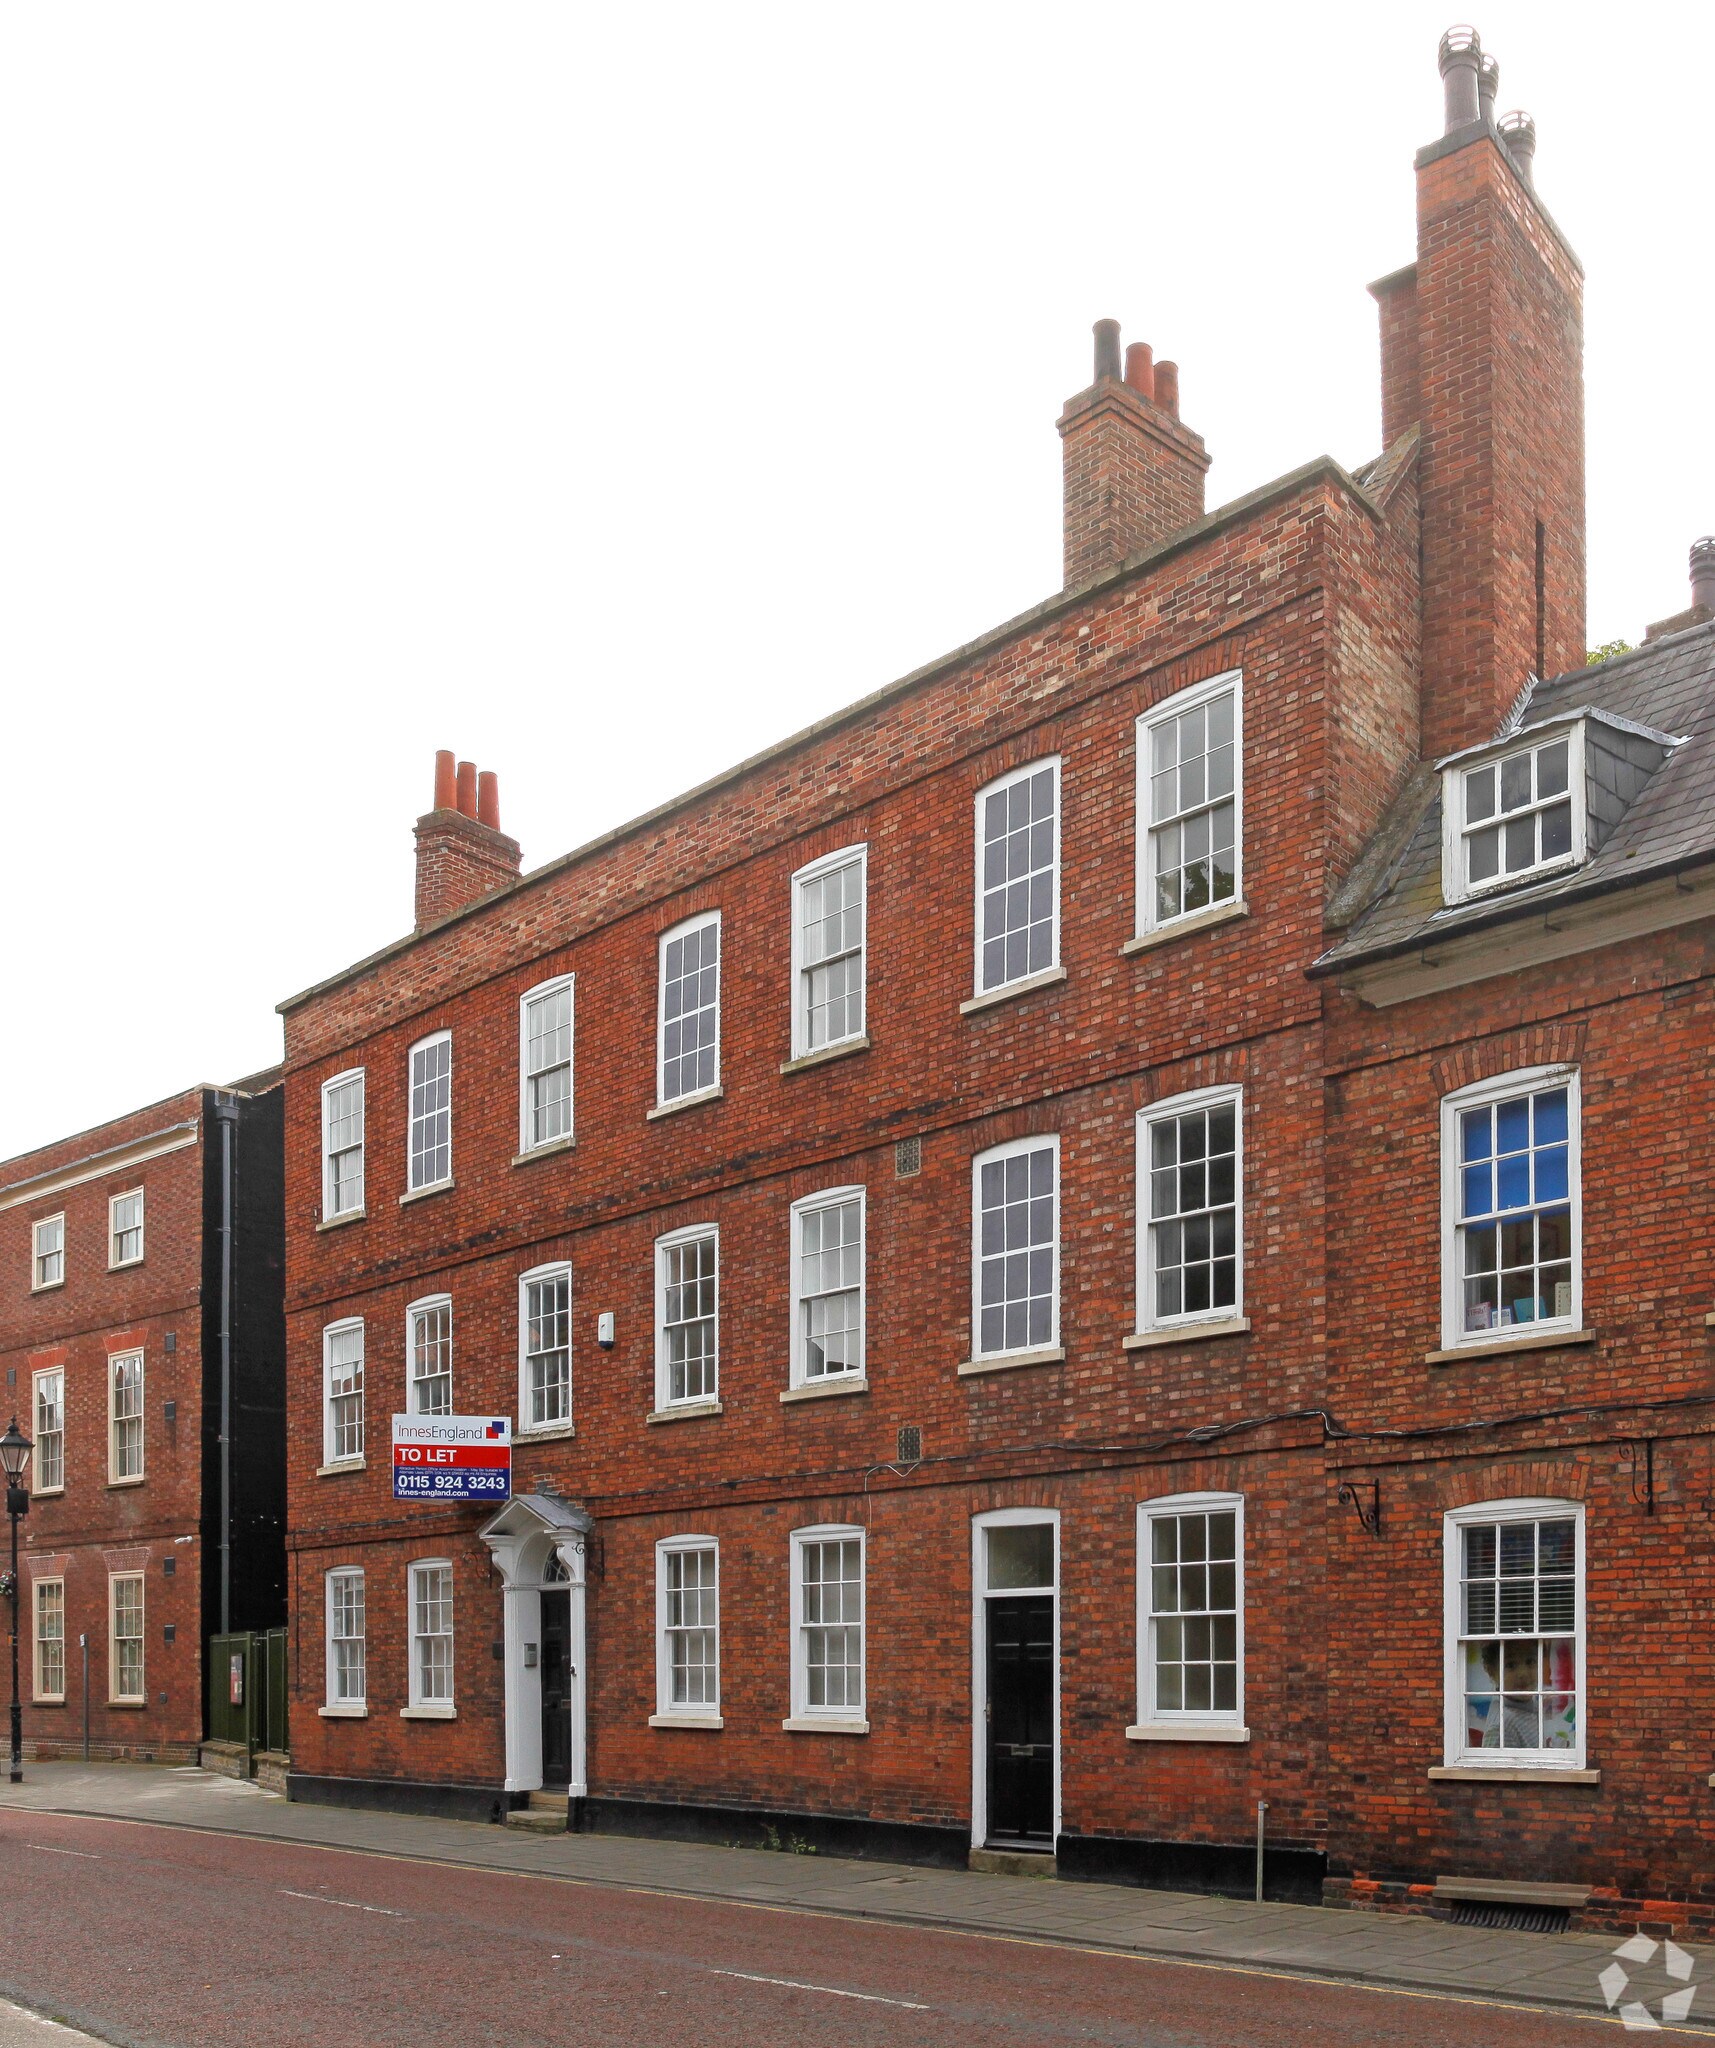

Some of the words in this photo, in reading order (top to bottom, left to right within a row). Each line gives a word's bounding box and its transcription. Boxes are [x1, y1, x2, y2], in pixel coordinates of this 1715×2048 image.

[398, 1425, 482, 1441] InnesEngland
[399, 1449, 421, 1462] TO
[427, 1449, 457, 1462] LET
[398, 1475, 429, 1488] 0115
[435, 1476, 463, 1489] 924
[468, 1477, 505, 1489] 3243
[398, 1488, 469, 1497] innes-england.com
